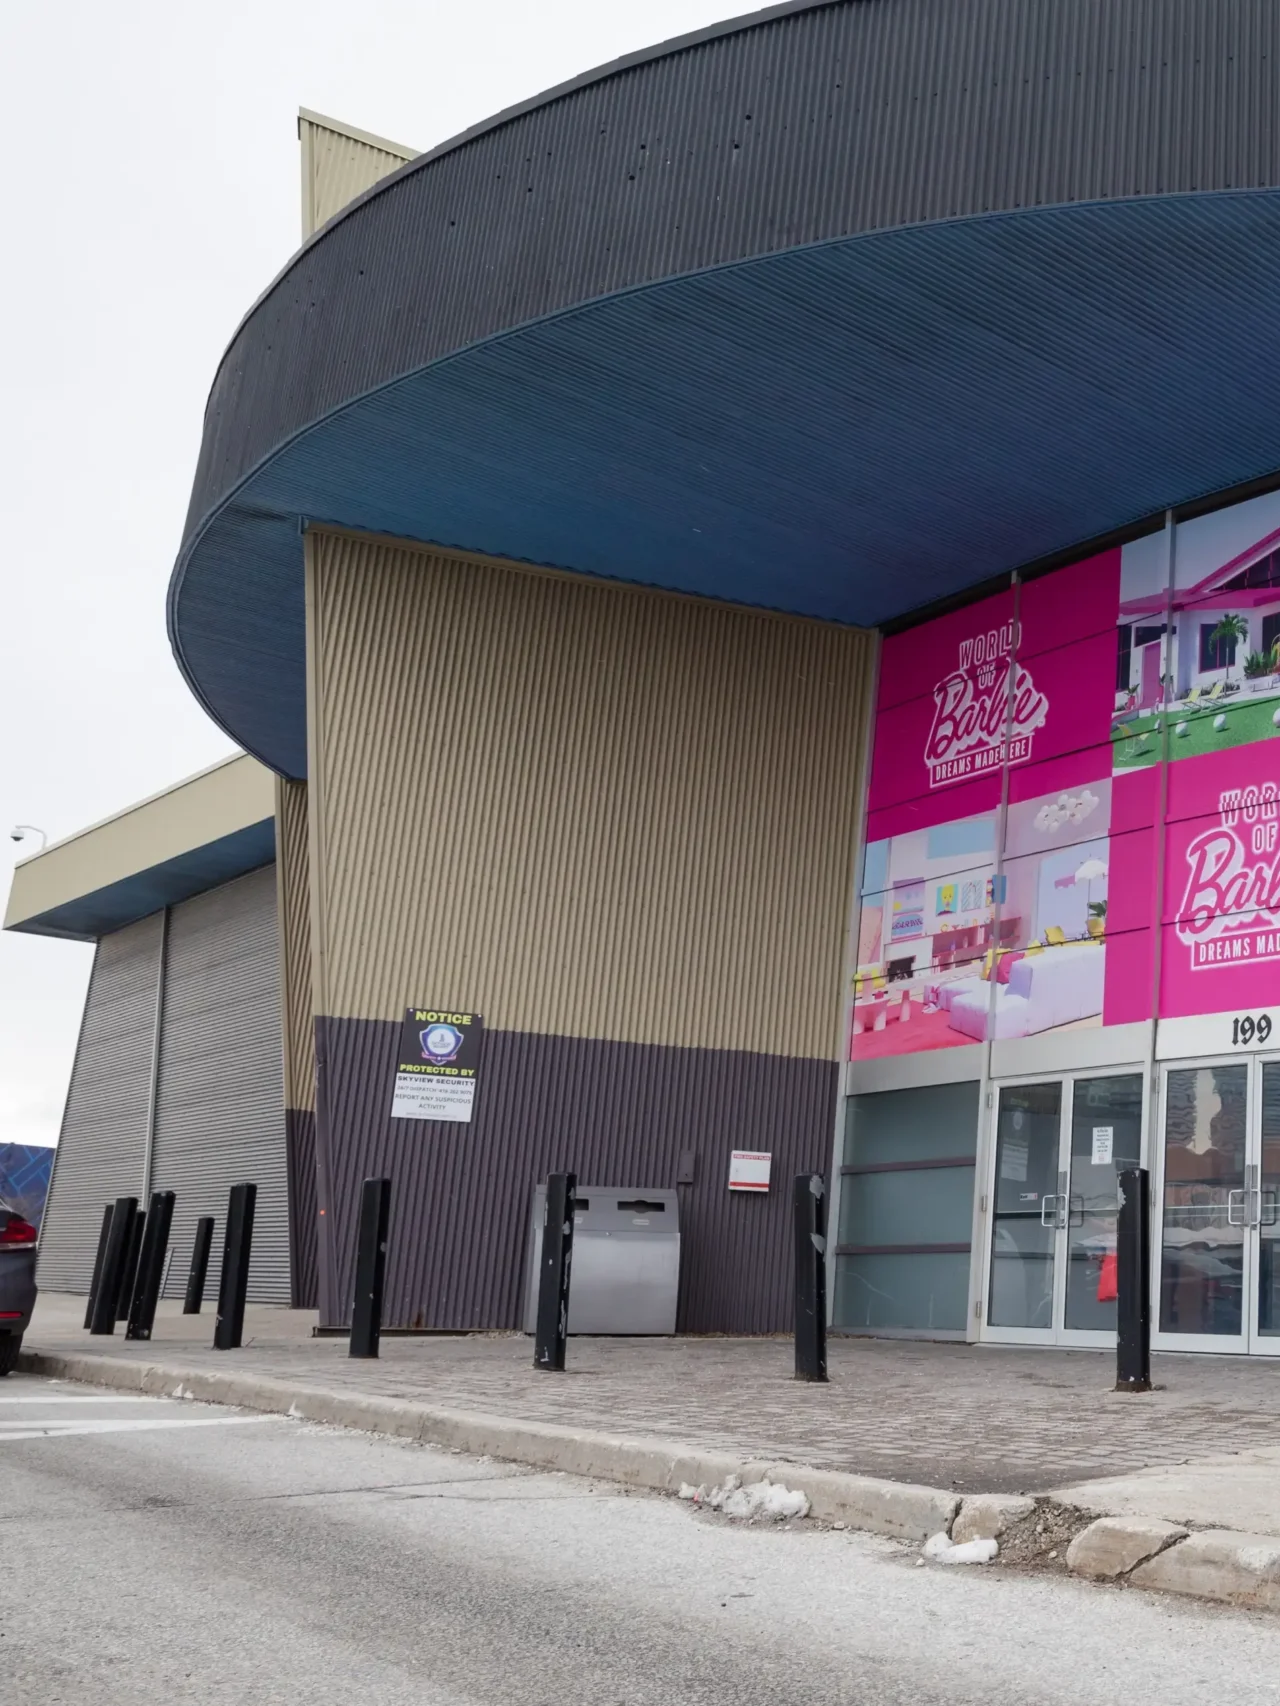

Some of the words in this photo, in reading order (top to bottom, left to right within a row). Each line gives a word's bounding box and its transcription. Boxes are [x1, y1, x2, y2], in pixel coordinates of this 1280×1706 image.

[959, 618, 1022, 670] WORLD
[977, 662, 996, 689] OF
[925, 660, 1047, 764] Barbie
[935, 757, 972, 781] DREAMS
[975, 748, 1000, 769] MADE
[1000, 739, 1026, 760] HERE
[1253, 822, 1278, 854] OF
[1199, 938, 1250, 963] DREAMS
[415, 1010, 472, 1025] NOTICE
[1231, 1013, 1273, 1046] 199
[398, 1075, 433, 1084] SKYVIEW
[436, 1078, 474, 1087] SECURITY
[400, 1064, 459, 1075] PROTECTED
[460, 1069, 474, 1077] BY
[395, 1093, 419, 1101] REPORT
[435, 1096, 471, 1105] SUSPICIOUS
[418, 1103, 446, 1111] ACTIVITY
